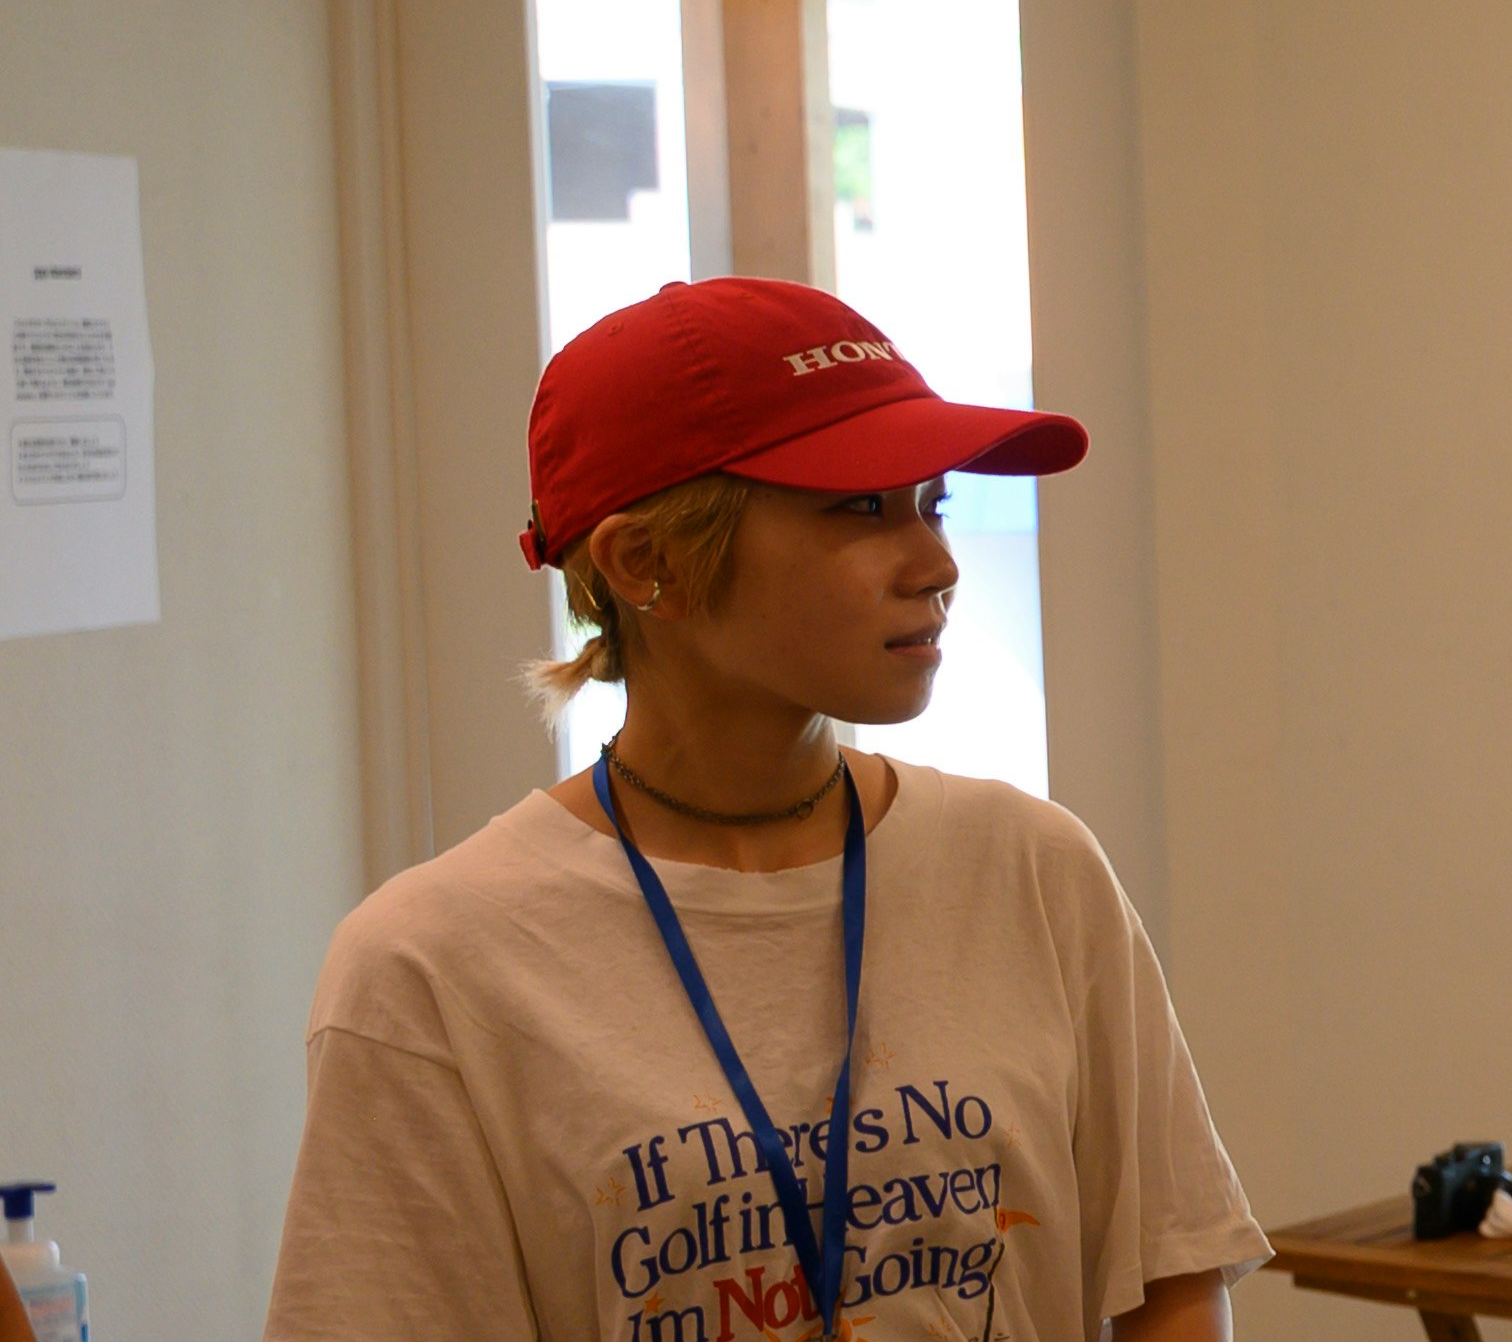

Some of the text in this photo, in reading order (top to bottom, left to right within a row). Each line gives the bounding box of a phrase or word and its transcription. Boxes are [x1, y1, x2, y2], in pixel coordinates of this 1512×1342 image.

[623, 1136, 675, 1212] If
[895, 1080, 992, 1146] No
[611, 1194, 731, 1299] Golf
[739, 1192, 792, 1255] in
[842, 1237, 997, 1309] Going
